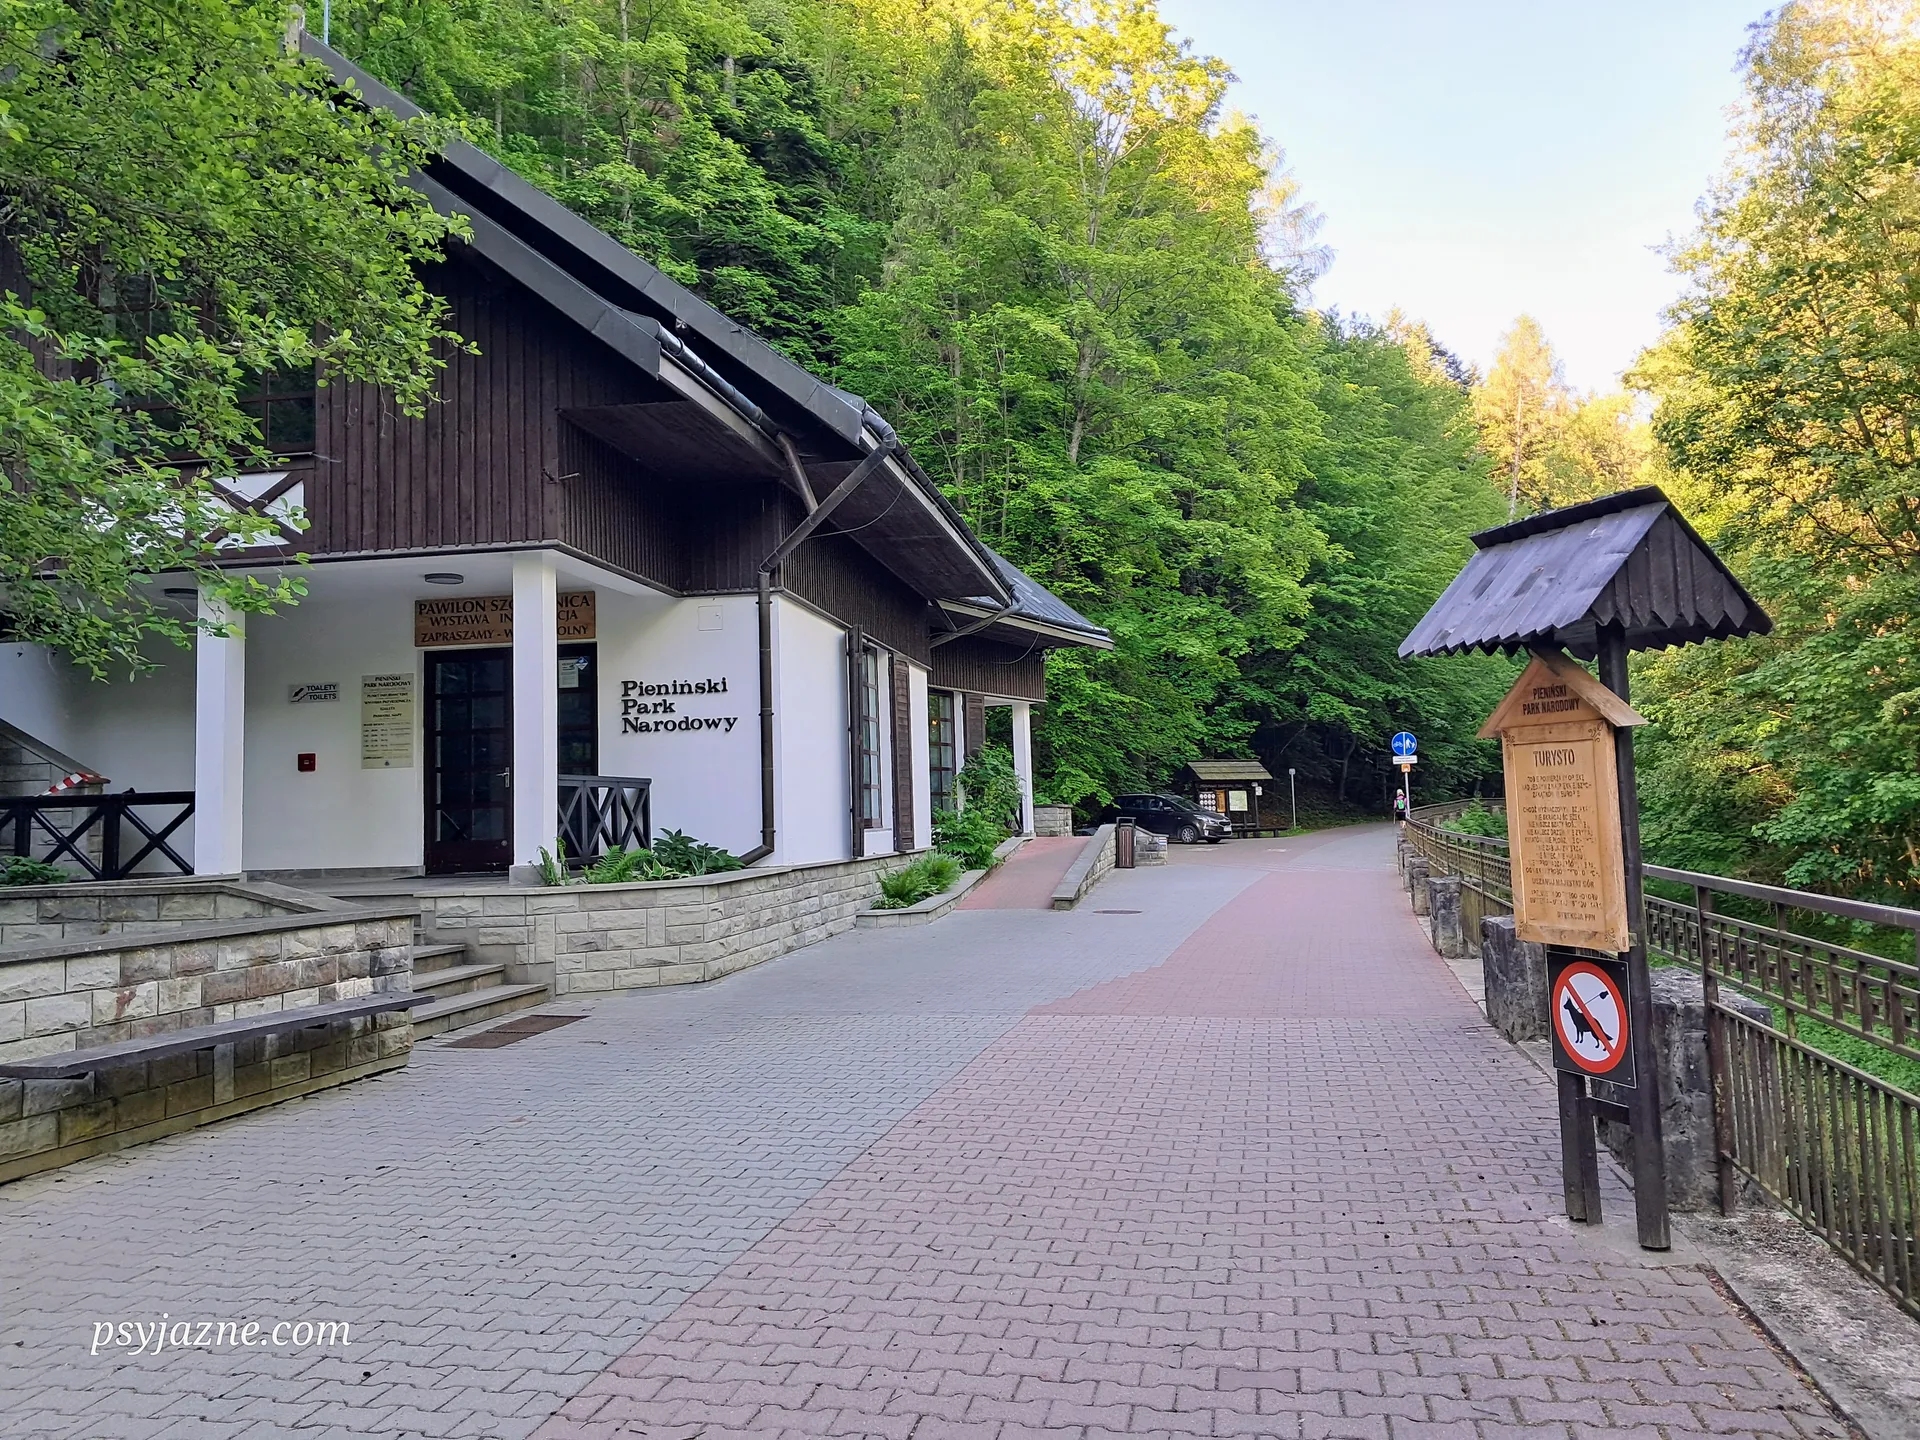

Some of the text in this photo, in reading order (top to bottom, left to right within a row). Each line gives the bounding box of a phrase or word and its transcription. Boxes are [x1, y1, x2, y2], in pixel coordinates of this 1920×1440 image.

[418, 595, 590, 615] PAWILON SZCNICA
[430, 616, 490, 626] WYSTAWA
[421, 630, 495, 643] ZAPRASZAMY
[557, 625, 588, 636] OLNY
[306, 684, 337, 692] TOALETY
[621, 677, 728, 697] Pieniński
[1533, 684, 1567, 699] PIENIŃSKI
[621, 699, 676, 715] Park
[1523, 698, 1580, 715] PARK NARODOWY
[621, 716, 738, 733] Narodowy
[1533, 748, 1575, 767] TURYSTO
